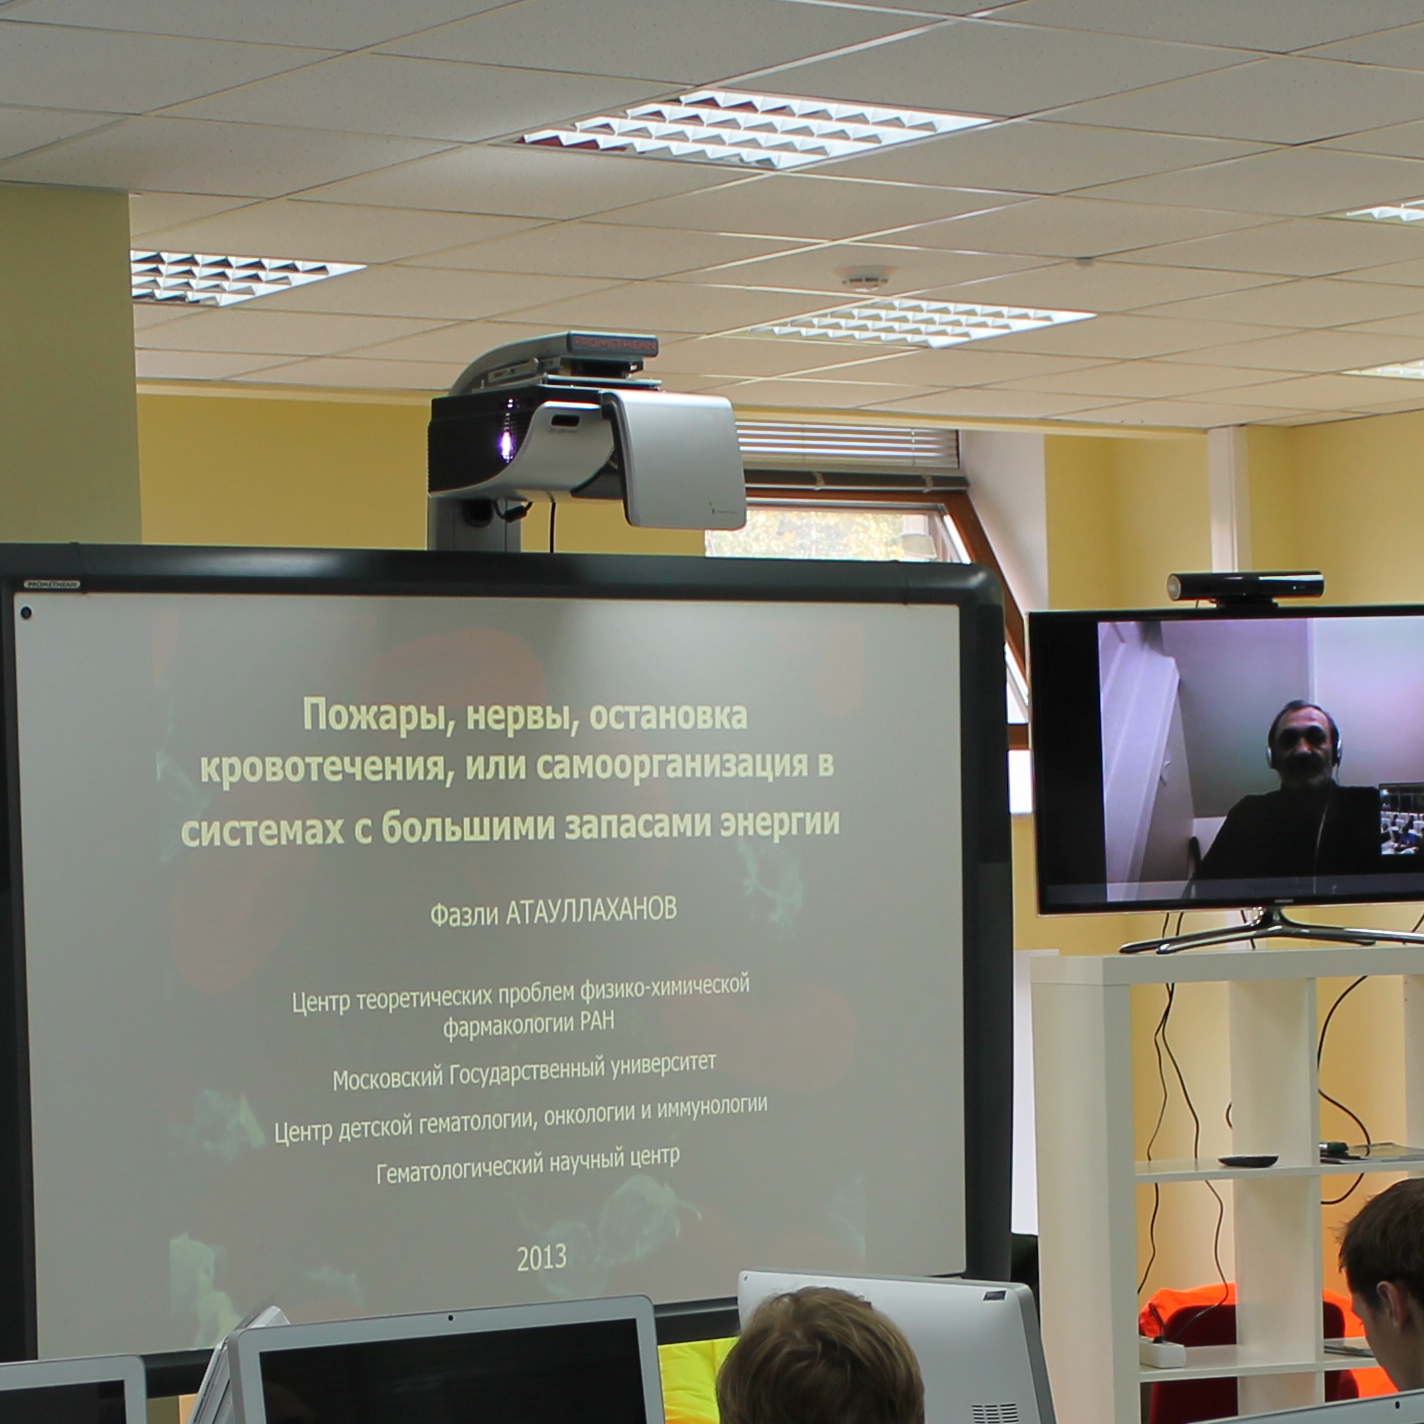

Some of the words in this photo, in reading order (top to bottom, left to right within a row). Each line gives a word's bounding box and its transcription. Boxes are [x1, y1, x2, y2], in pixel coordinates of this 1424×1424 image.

[303, 695, 456, 738] Пожары,
[466, 701, 580, 739] нервы,
[590, 704, 748, 731] остановка
[200, 753, 456, 792] кровотечения,
[465, 753, 527, 781] или
[536, 751, 810, 787] самоорганизация
[819, 752, 835, 777] в
[181, 815, 345, 848] системах
[354, 816, 373, 845] с
[381, 808, 555, 845] большими
[564, 811, 712, 841] запасами
[720, 810, 841, 843] энергии
[429, 901, 499, 929] Фазли
[506, 895, 678, 925] АТАУЛЛАХАНОВ
[292, 990, 351, 1017] Центр
[356, 985, 493, 1014] теоретических
[498, 981, 575, 1008] проблем
[580, 971, 750, 1006] физико-химической
[443, 1011, 575, 1043] фармакологии
[580, 1010, 615, 1032] РАН
[333, 1064, 444, 1092] Московский
[449, 1055, 605, 1087] Государственный
[610, 1051, 717, 1081] университет
[275, 1120, 333, 1147] Центр
[338, 1112, 413, 1143] детской
[419, 1109, 539, 1137] гематологии,
[544, 1102, 636, 1129] онкологии
[641, 1102, 652, 1120] и
[657, 1092, 769, 1122] иммунологии
[376, 1151, 544, 1186] Гематологический
[549, 1146, 625, 1174] научный
[629, 1144, 681, 1170] центр
[516, 1244, 568, 1273] 2013
